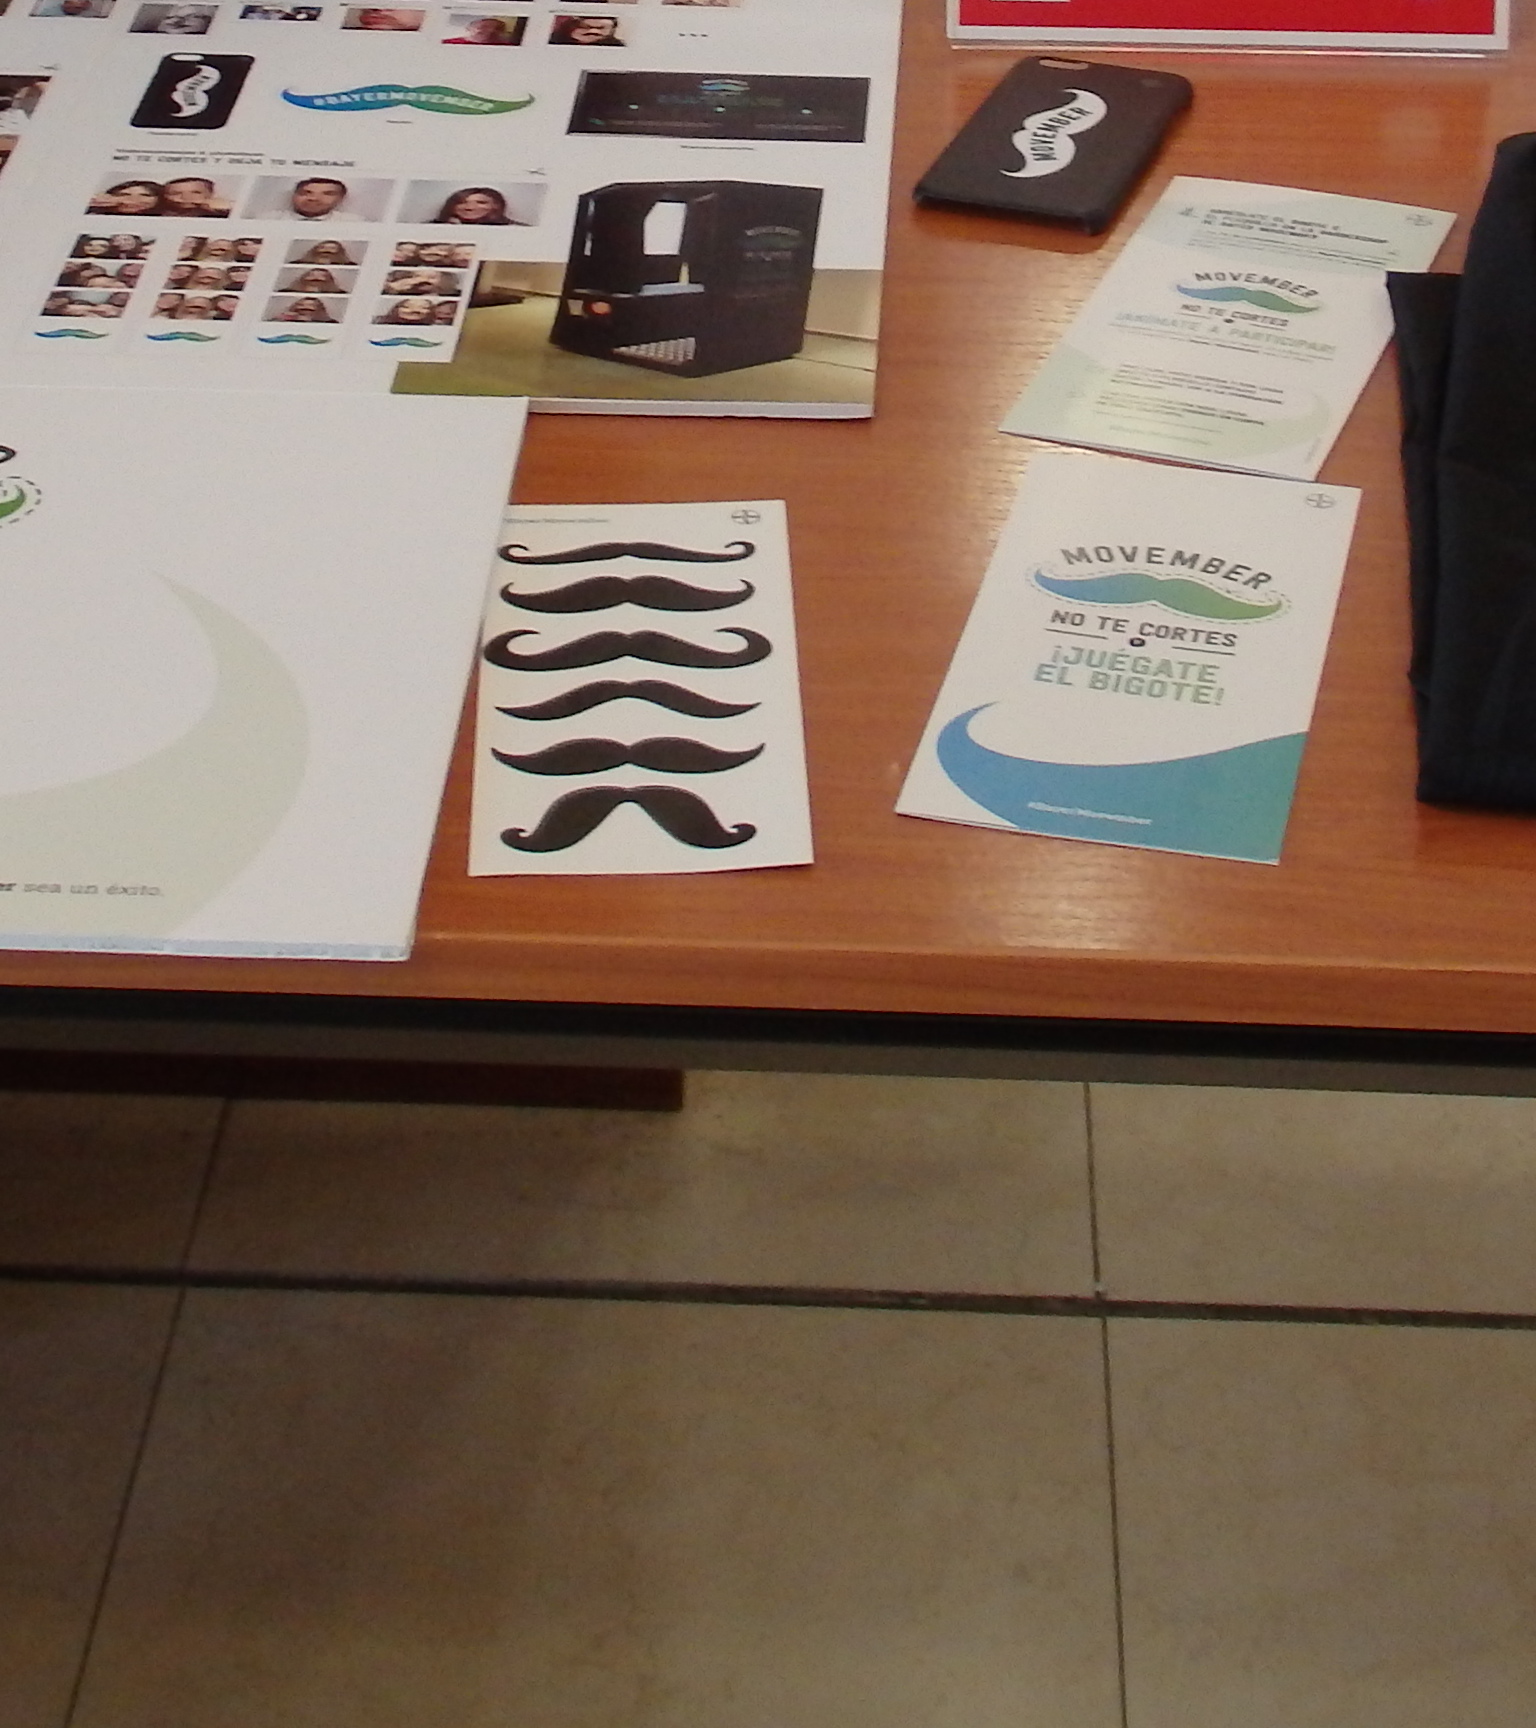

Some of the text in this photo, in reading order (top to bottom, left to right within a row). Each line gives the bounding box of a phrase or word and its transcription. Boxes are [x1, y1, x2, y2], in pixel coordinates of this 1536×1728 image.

[1029, 106, 1094, 162] MOVEMBER
[1194, 271, 1320, 299] MOVEMBER
[1060, 545, 1273, 592] MOVEMBER
[1050, 608, 1239, 649] NO TE CORTES
[1033, 664, 1226, 707] EL BIGOTE!
